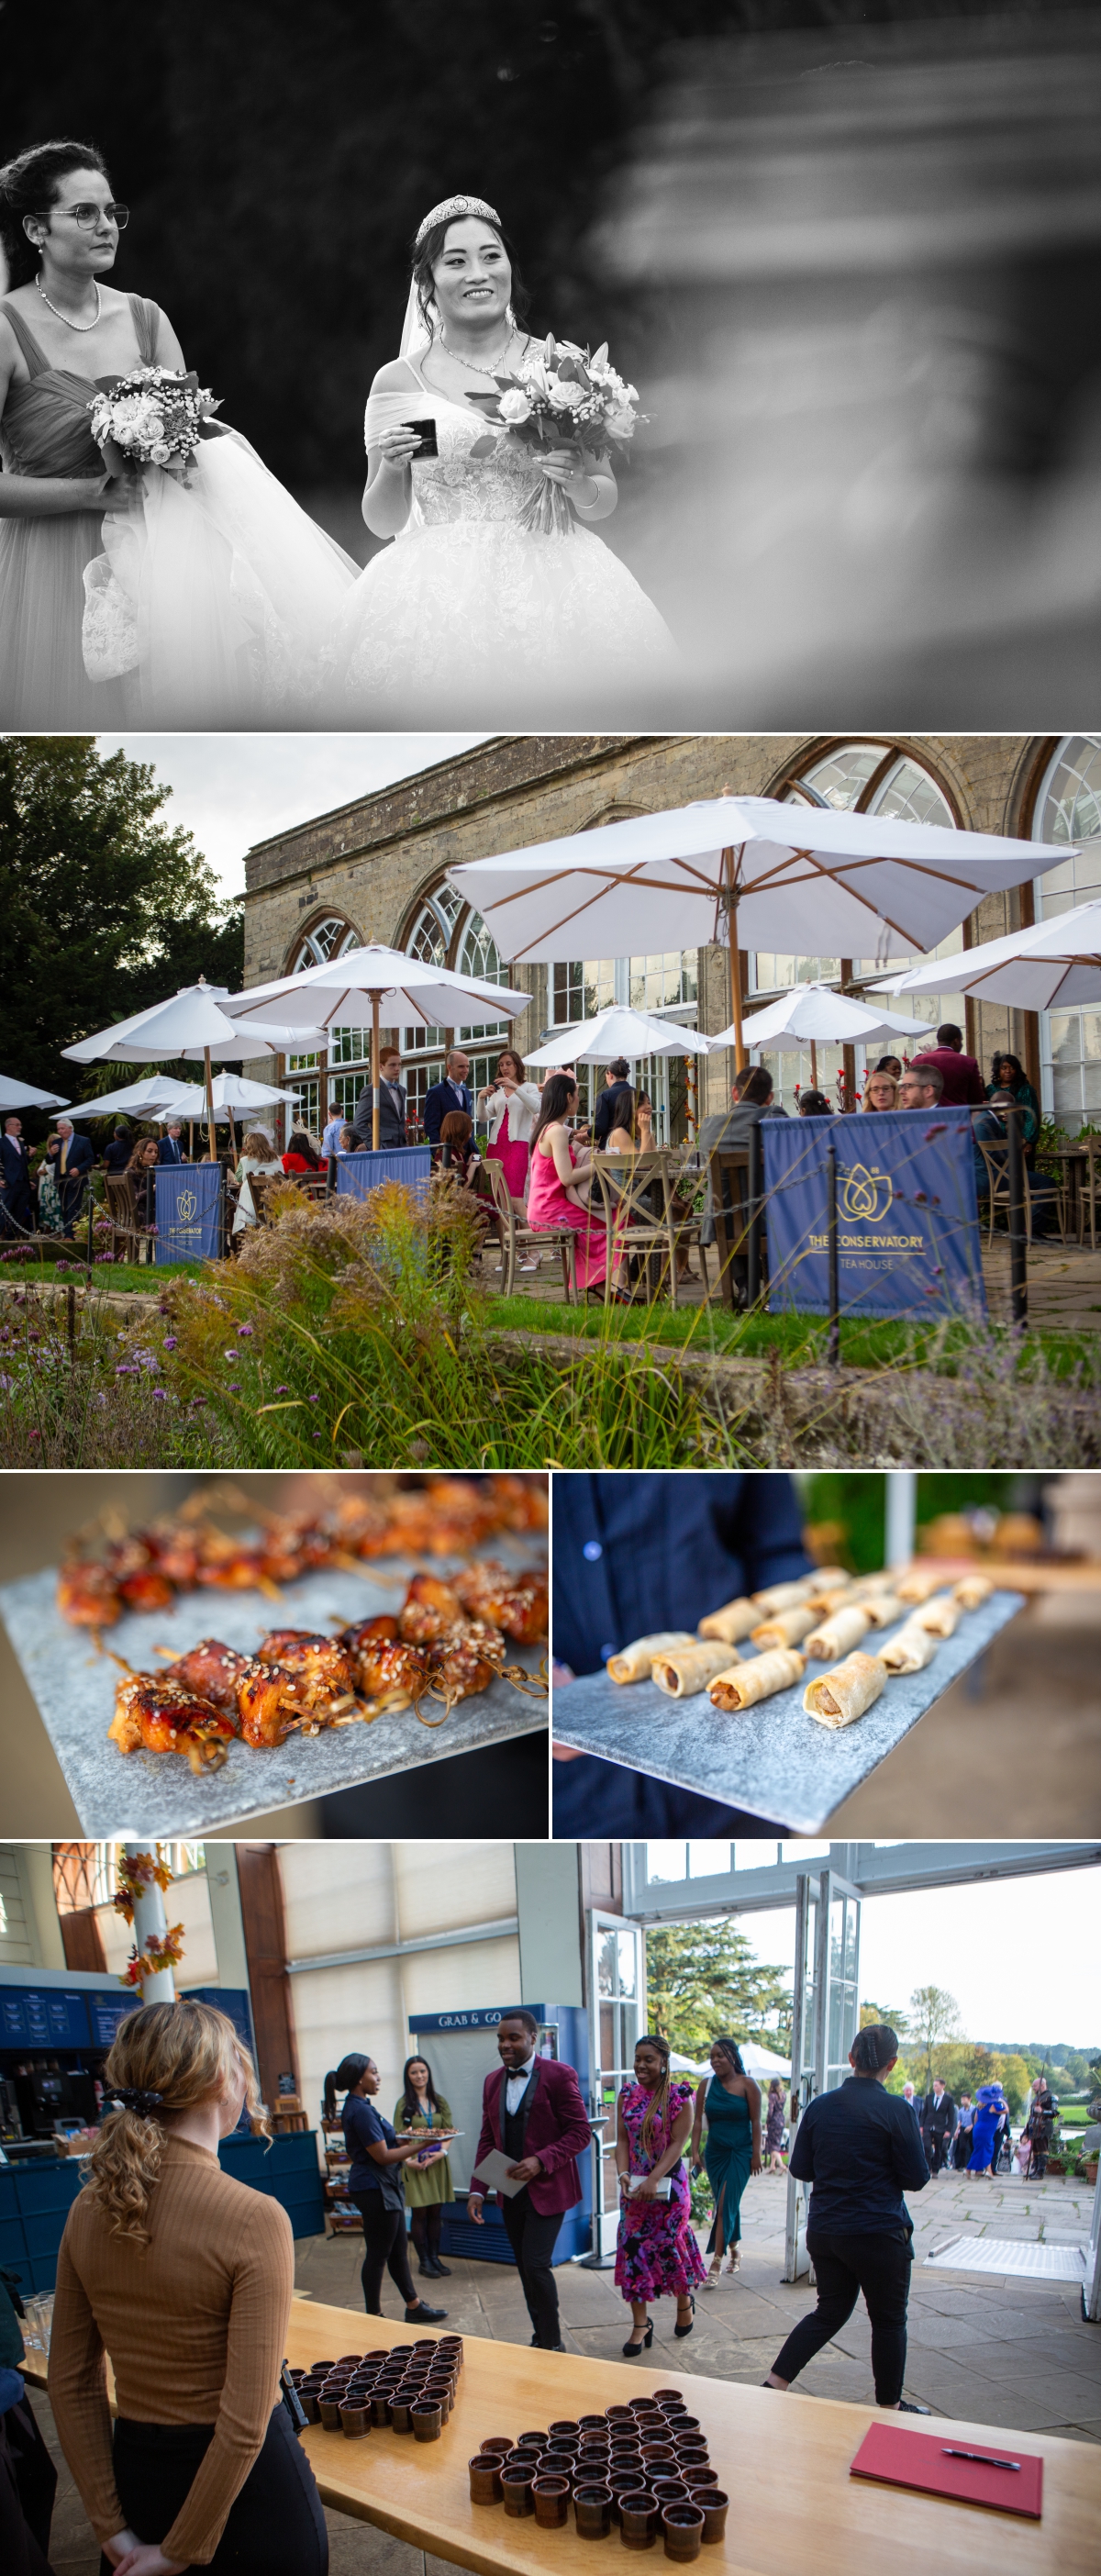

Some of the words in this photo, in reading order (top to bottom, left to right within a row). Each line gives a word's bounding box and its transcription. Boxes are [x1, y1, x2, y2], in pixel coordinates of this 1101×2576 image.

[808, 1235, 829, 1247] THE
[840, 1258, 857, 1269] TEA
[858, 1259, 894, 1270] HOUSE
[439, 2014, 468, 2027] GRAB
[471, 2013, 479, 2024] &
[484, 2012, 502, 2024] GO
